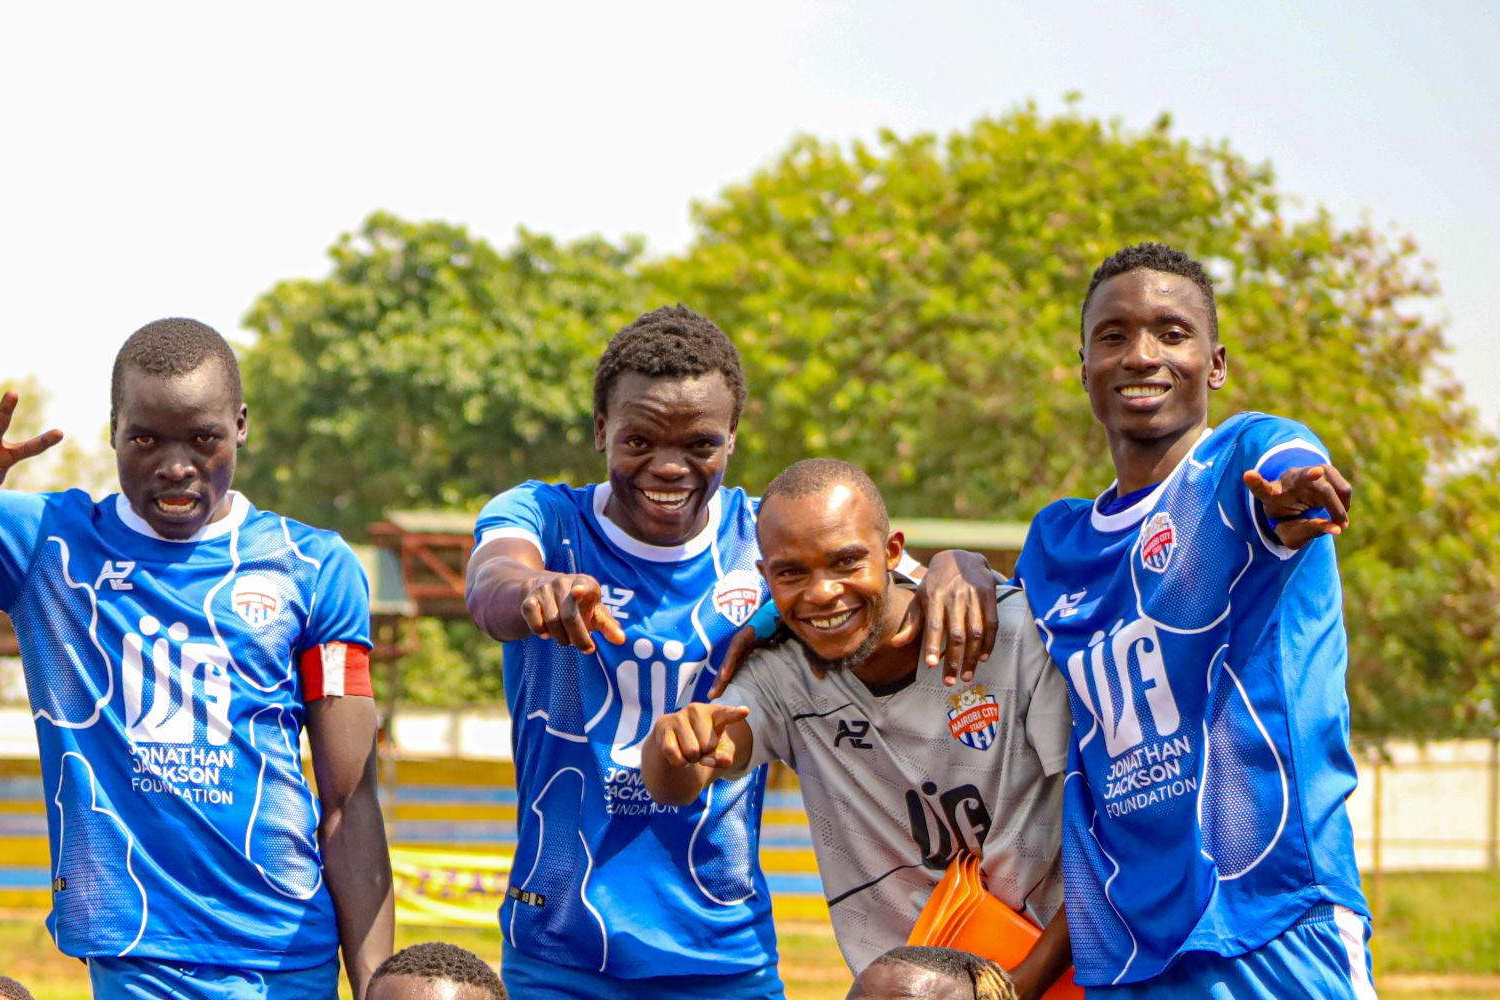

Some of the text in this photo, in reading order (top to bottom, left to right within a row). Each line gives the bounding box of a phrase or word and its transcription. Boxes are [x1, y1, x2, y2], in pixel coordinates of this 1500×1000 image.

[94, 559, 136, 590] AZ
[1045, 587, 1087, 620] AZ
[834, 719, 873, 750] AZ
[951, 707, 998, 734] NAIROBI CITY
[129, 747, 234, 768] JONATHAN
[1106, 735, 1191, 782] JONATHAN
[604, 785, 652, 802] JACKS
[1103, 759, 1182, 801] JACKSON
[1106, 776, 1197, 819] FOUNDATION
